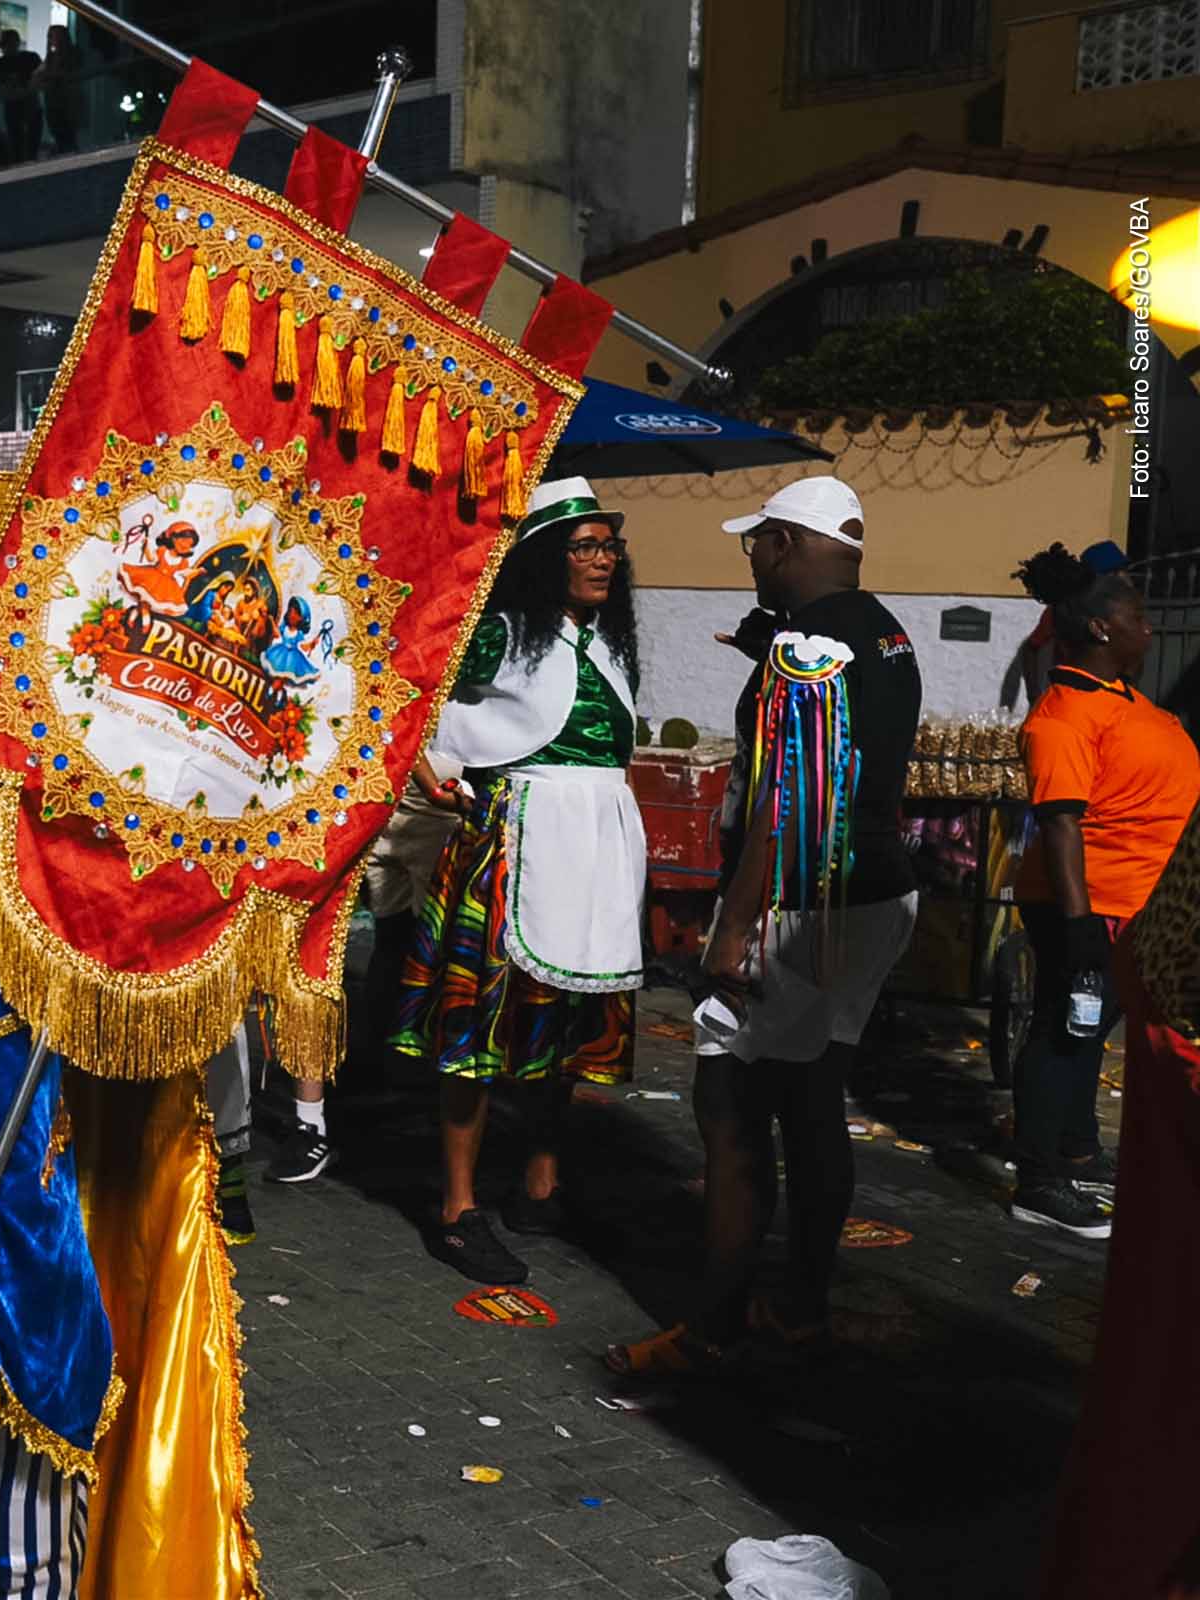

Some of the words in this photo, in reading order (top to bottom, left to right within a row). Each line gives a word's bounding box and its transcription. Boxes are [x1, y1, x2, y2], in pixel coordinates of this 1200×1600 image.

[120, 658, 193, 703] Canto
[193, 690, 216, 712] de
[211, 701, 259, 749] Luz
[141, 619, 266, 713] PASTORIL
